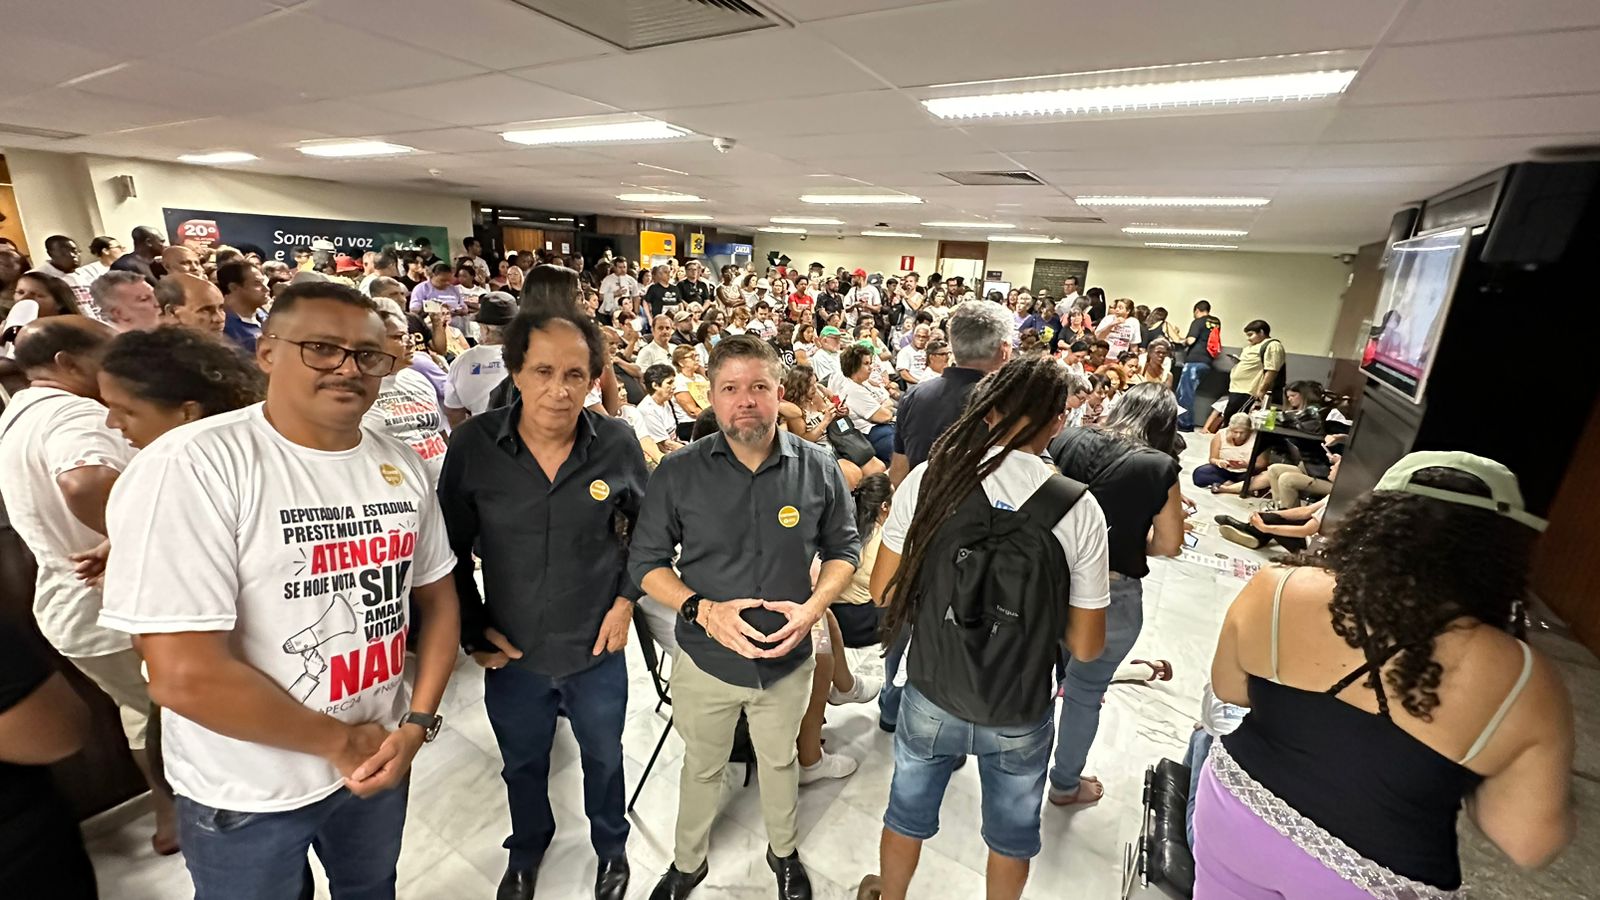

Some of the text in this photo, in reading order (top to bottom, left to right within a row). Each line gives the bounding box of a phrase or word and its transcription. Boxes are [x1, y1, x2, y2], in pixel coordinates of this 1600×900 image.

[333, 235, 343, 247] a
[347, 236, 374, 248] voz
[280, 506, 356, 525] DEPUTADO/A
[283, 519, 383, 545] PRESTE MUITA
[284, 572, 357, 600] SE HOJE VOTA
